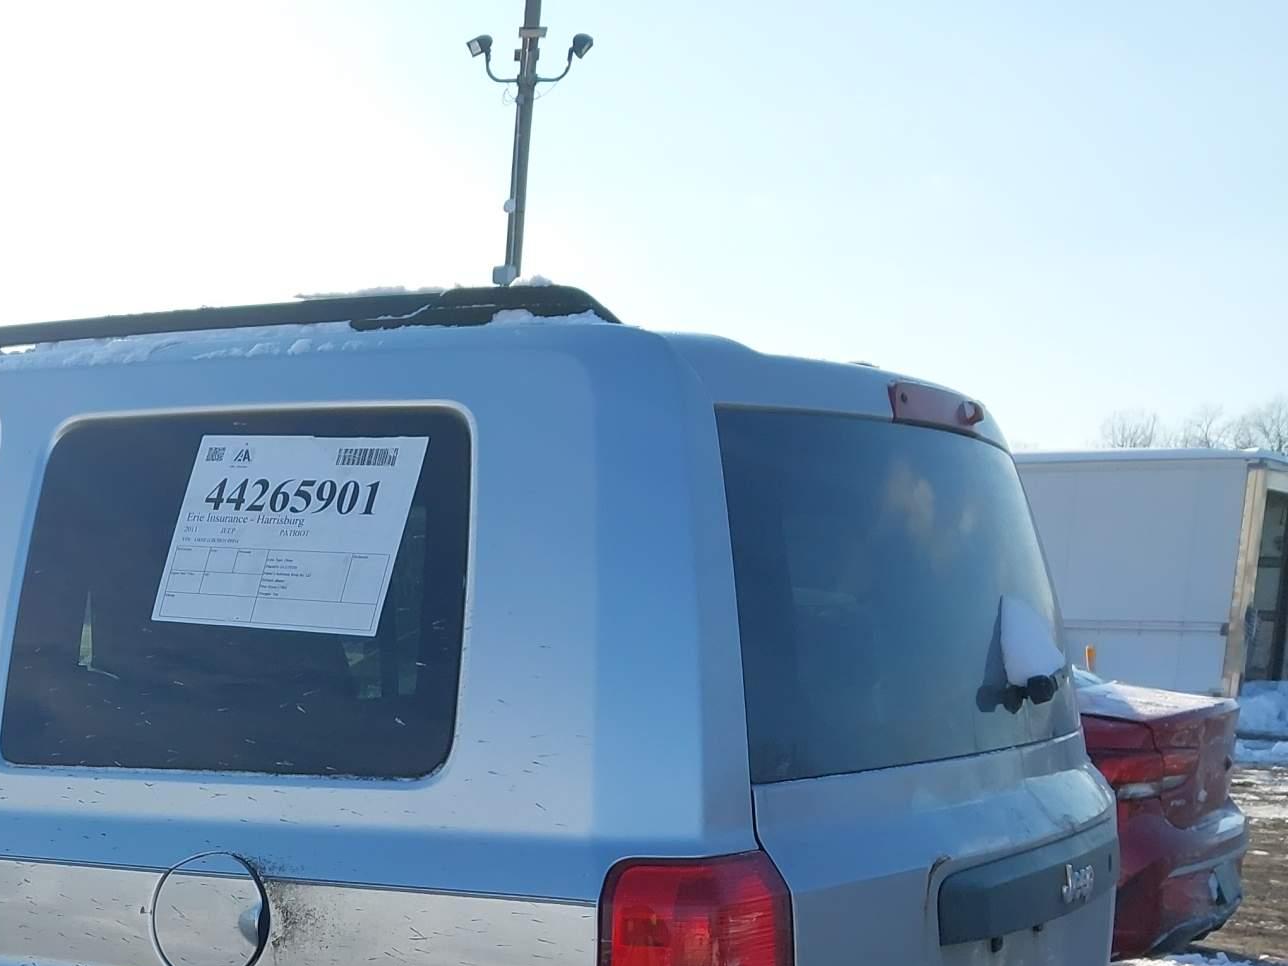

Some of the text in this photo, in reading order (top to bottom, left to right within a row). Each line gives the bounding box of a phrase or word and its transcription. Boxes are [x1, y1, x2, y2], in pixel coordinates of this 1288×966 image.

[205, 477, 381, 516] 44265901
[186, 511, 205, 522] Erie
[207, 512, 249, 525] Insurance
[256, 514, 305, 528] Harrisburg
[279, 529, 310, 537] PATRIOT
[1062, 863, 1095, 904] Jeep
